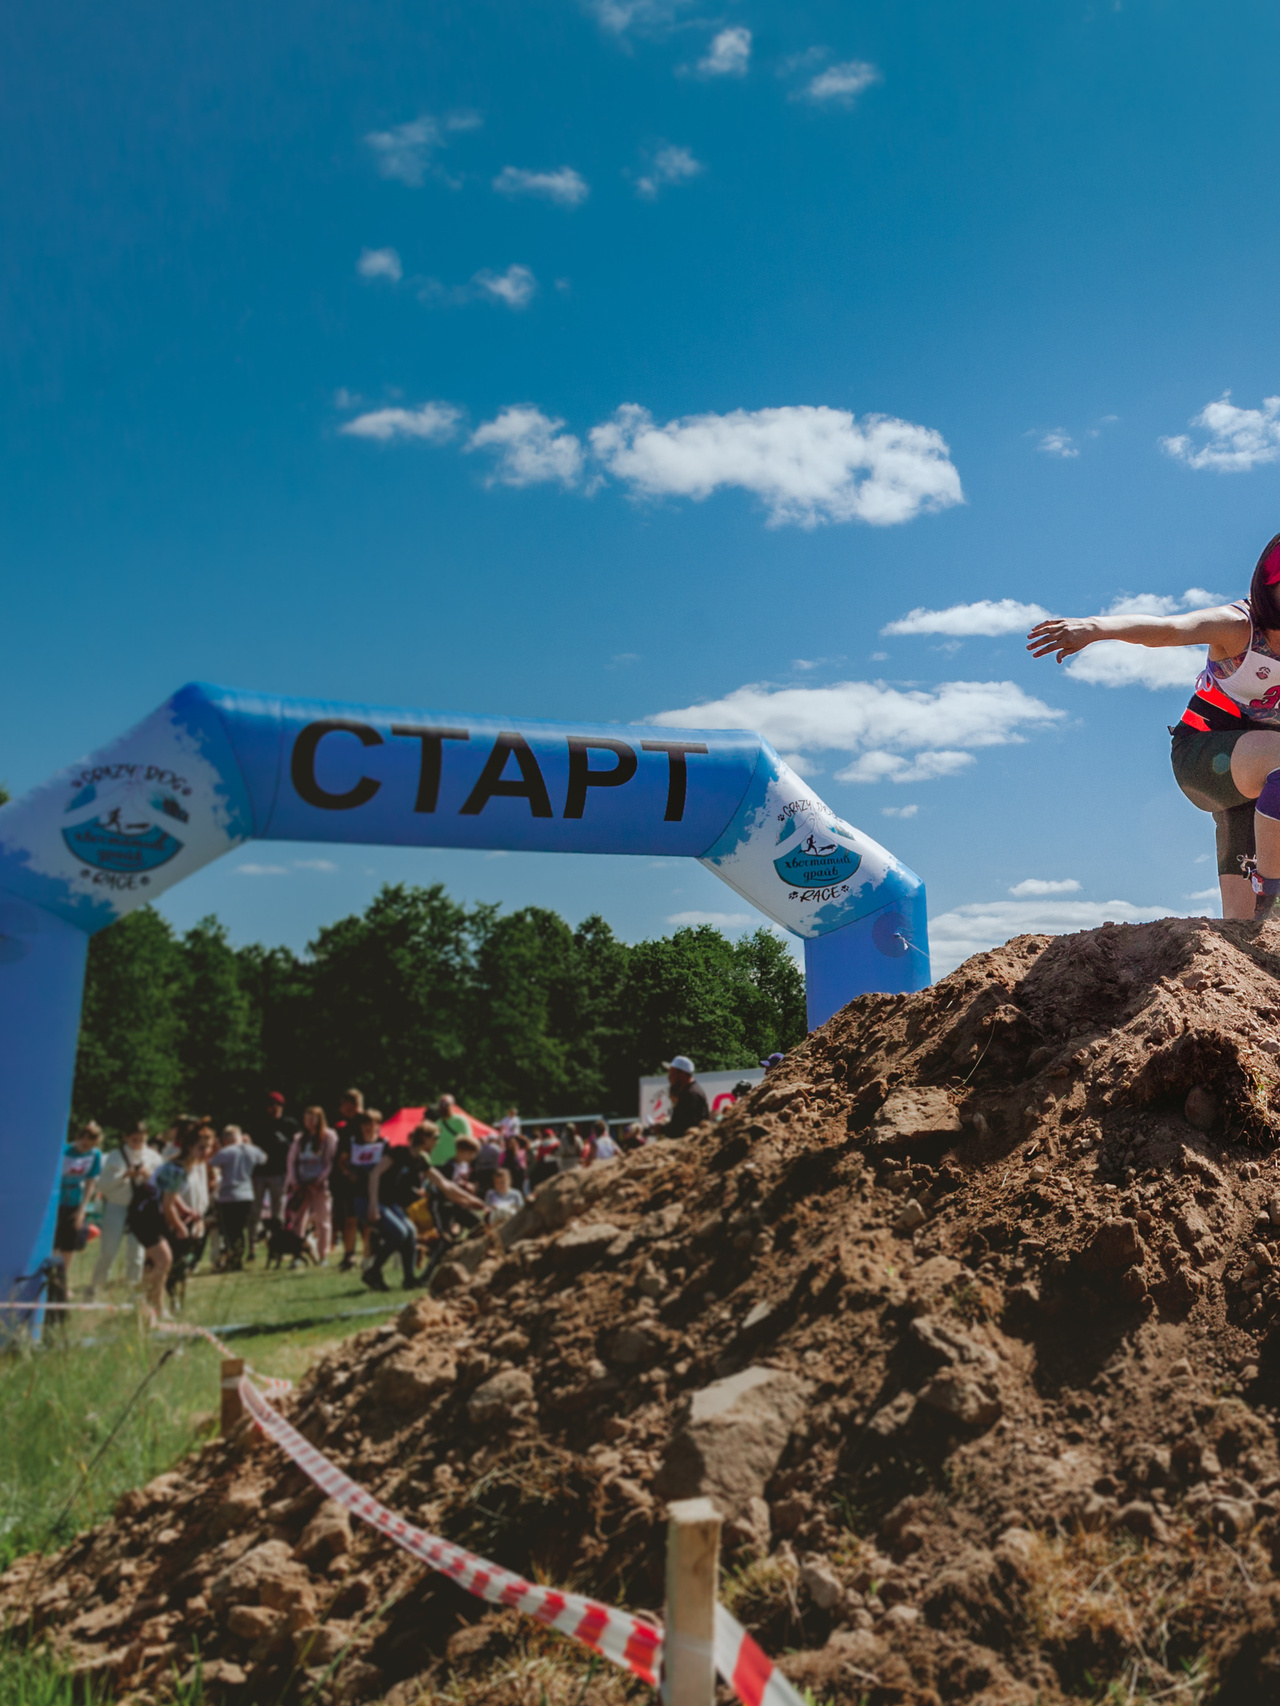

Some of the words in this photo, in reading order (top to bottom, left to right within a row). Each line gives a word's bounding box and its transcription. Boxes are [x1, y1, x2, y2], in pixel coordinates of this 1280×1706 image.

[80, 763, 136, 784] CRAZY
[144, 764, 188, 791] DOG
[290, 718, 709, 822] СТАРТ
[782, 799, 811, 818] CRAZY
[92, 870, 139, 891] RACE
[803, 866, 839, 884] драйв
[800, 886, 842, 902] RACE
